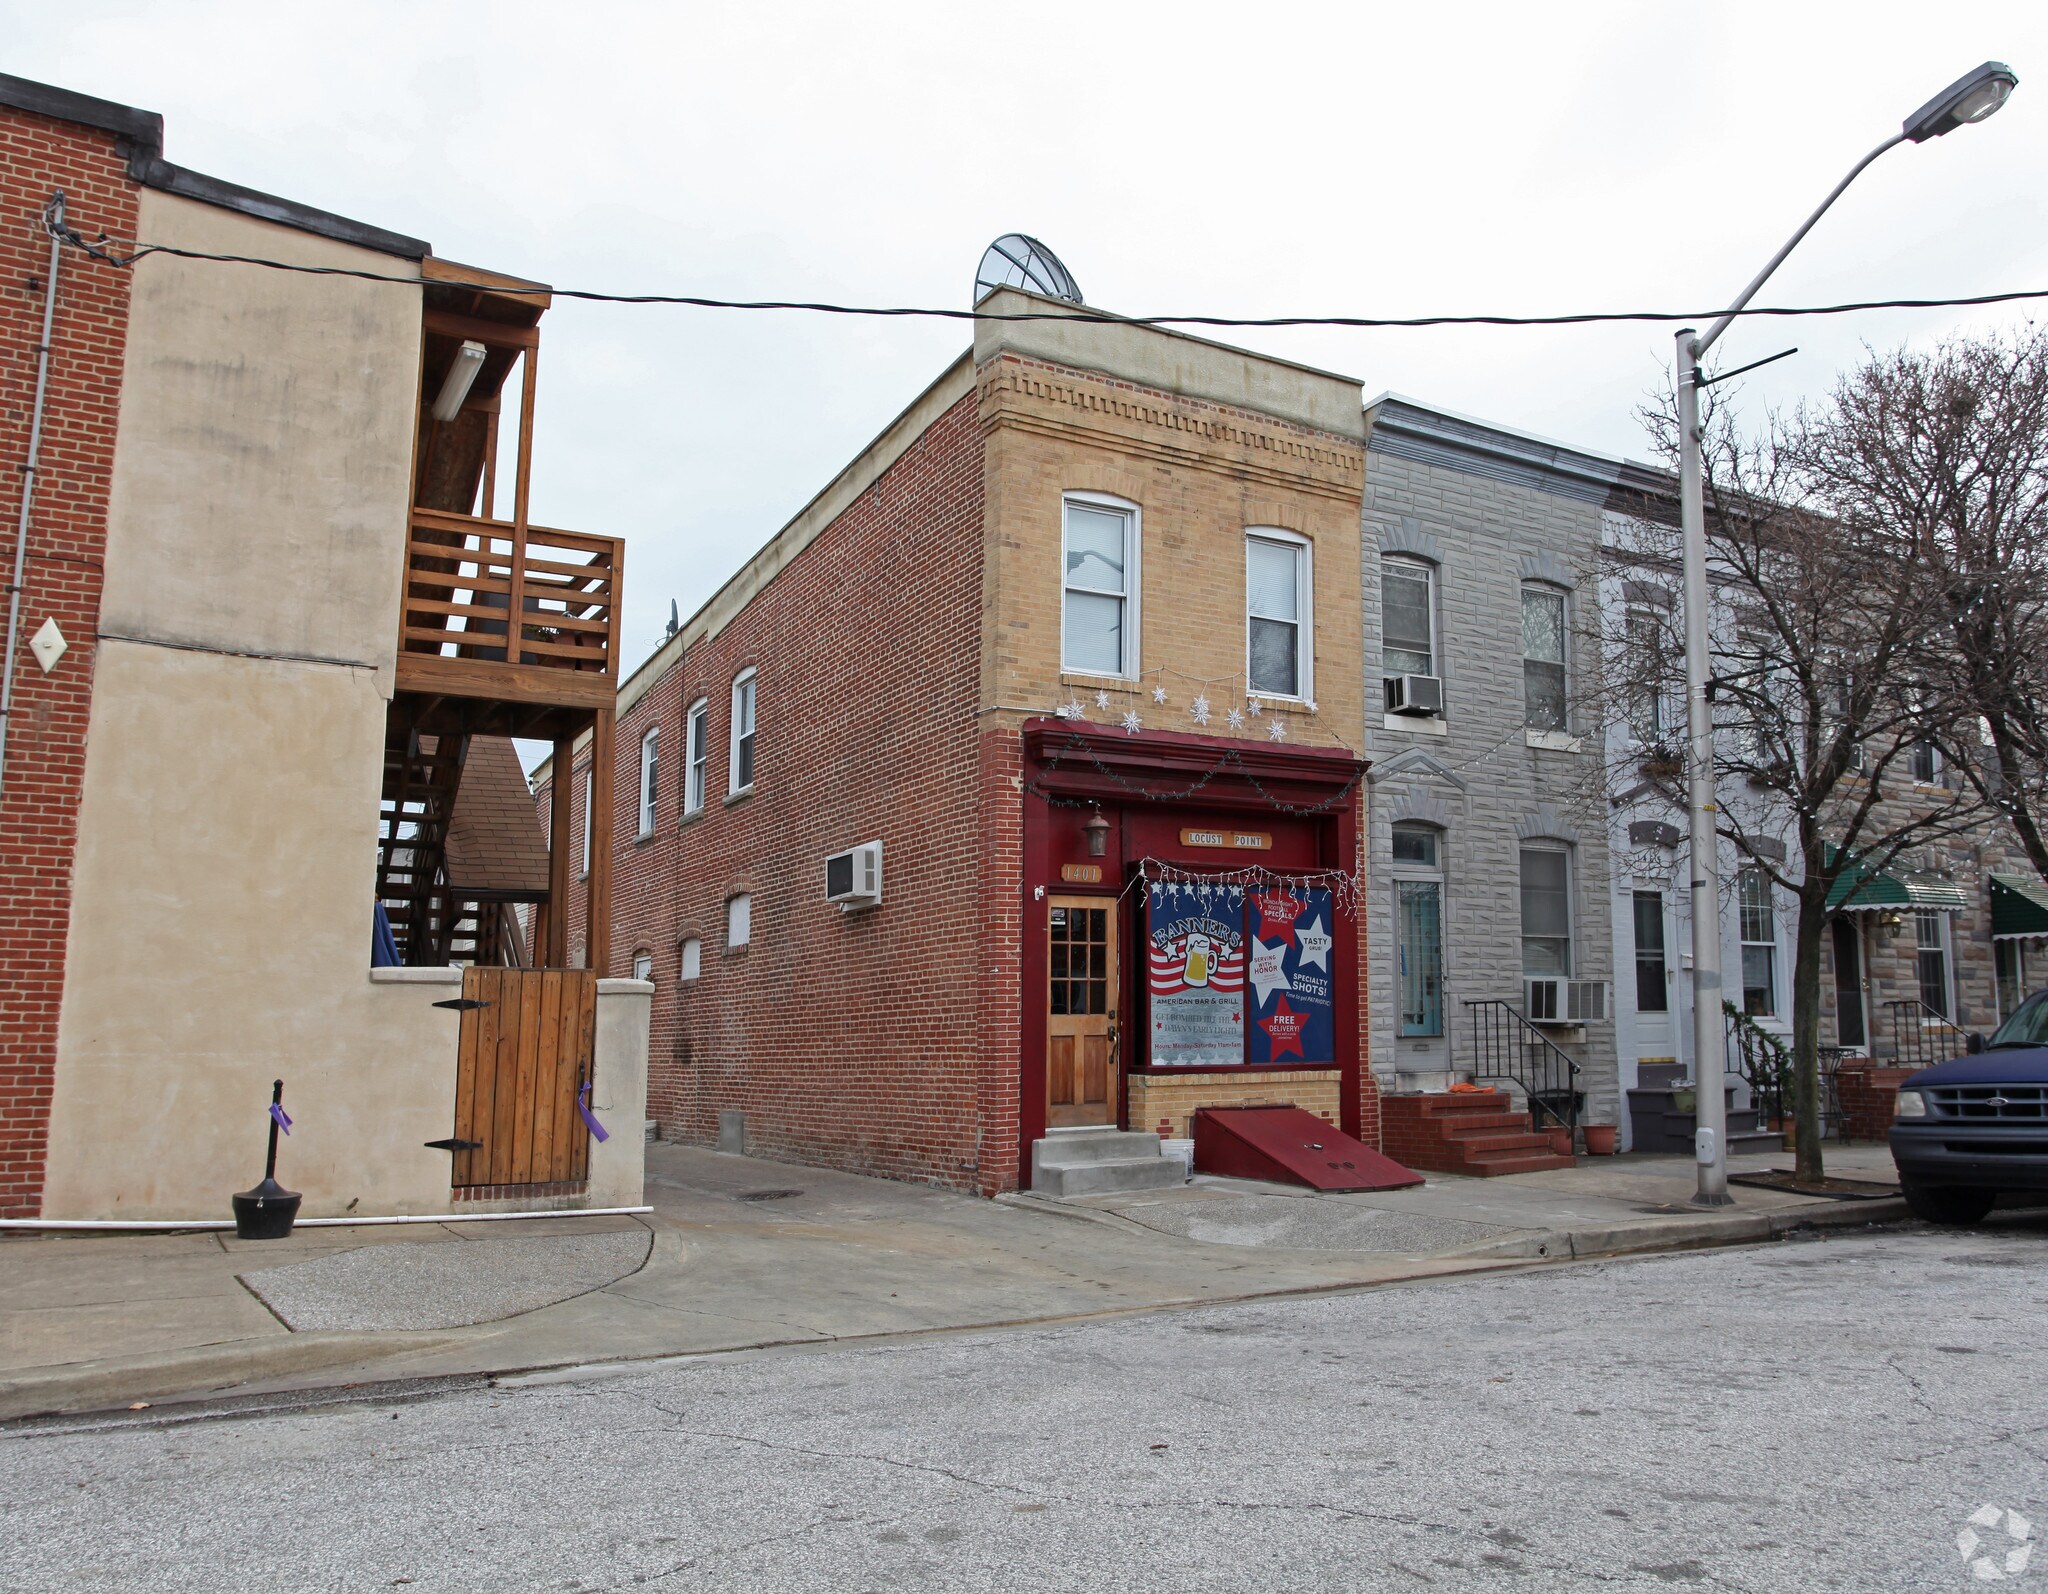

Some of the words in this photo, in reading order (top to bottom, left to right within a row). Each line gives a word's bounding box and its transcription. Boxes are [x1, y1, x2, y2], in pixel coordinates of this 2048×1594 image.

[1189, 833, 1222, 844] LOCUST
[1235, 835, 1261, 846] POINT
[1066, 866, 1096, 881] 1401
[1264, 910, 1292, 919] SPECIALS
[1152, 917, 1241, 948] BANNERS
[1303, 937, 1328, 945] TASTY
[1254, 955, 1276, 963] SERVING
[1254, 965, 1278, 975] HONOR
[1293, 973, 1328, 987] SPECIALTY
[1292, 981, 1327, 997] SHOTS!
[1286, 991, 1296, 999] Time
[1210, 997, 1216, 1005] &
[1273, 1015, 1295, 1025] FREE
[1193, 1025, 1213, 1034] EARLY
